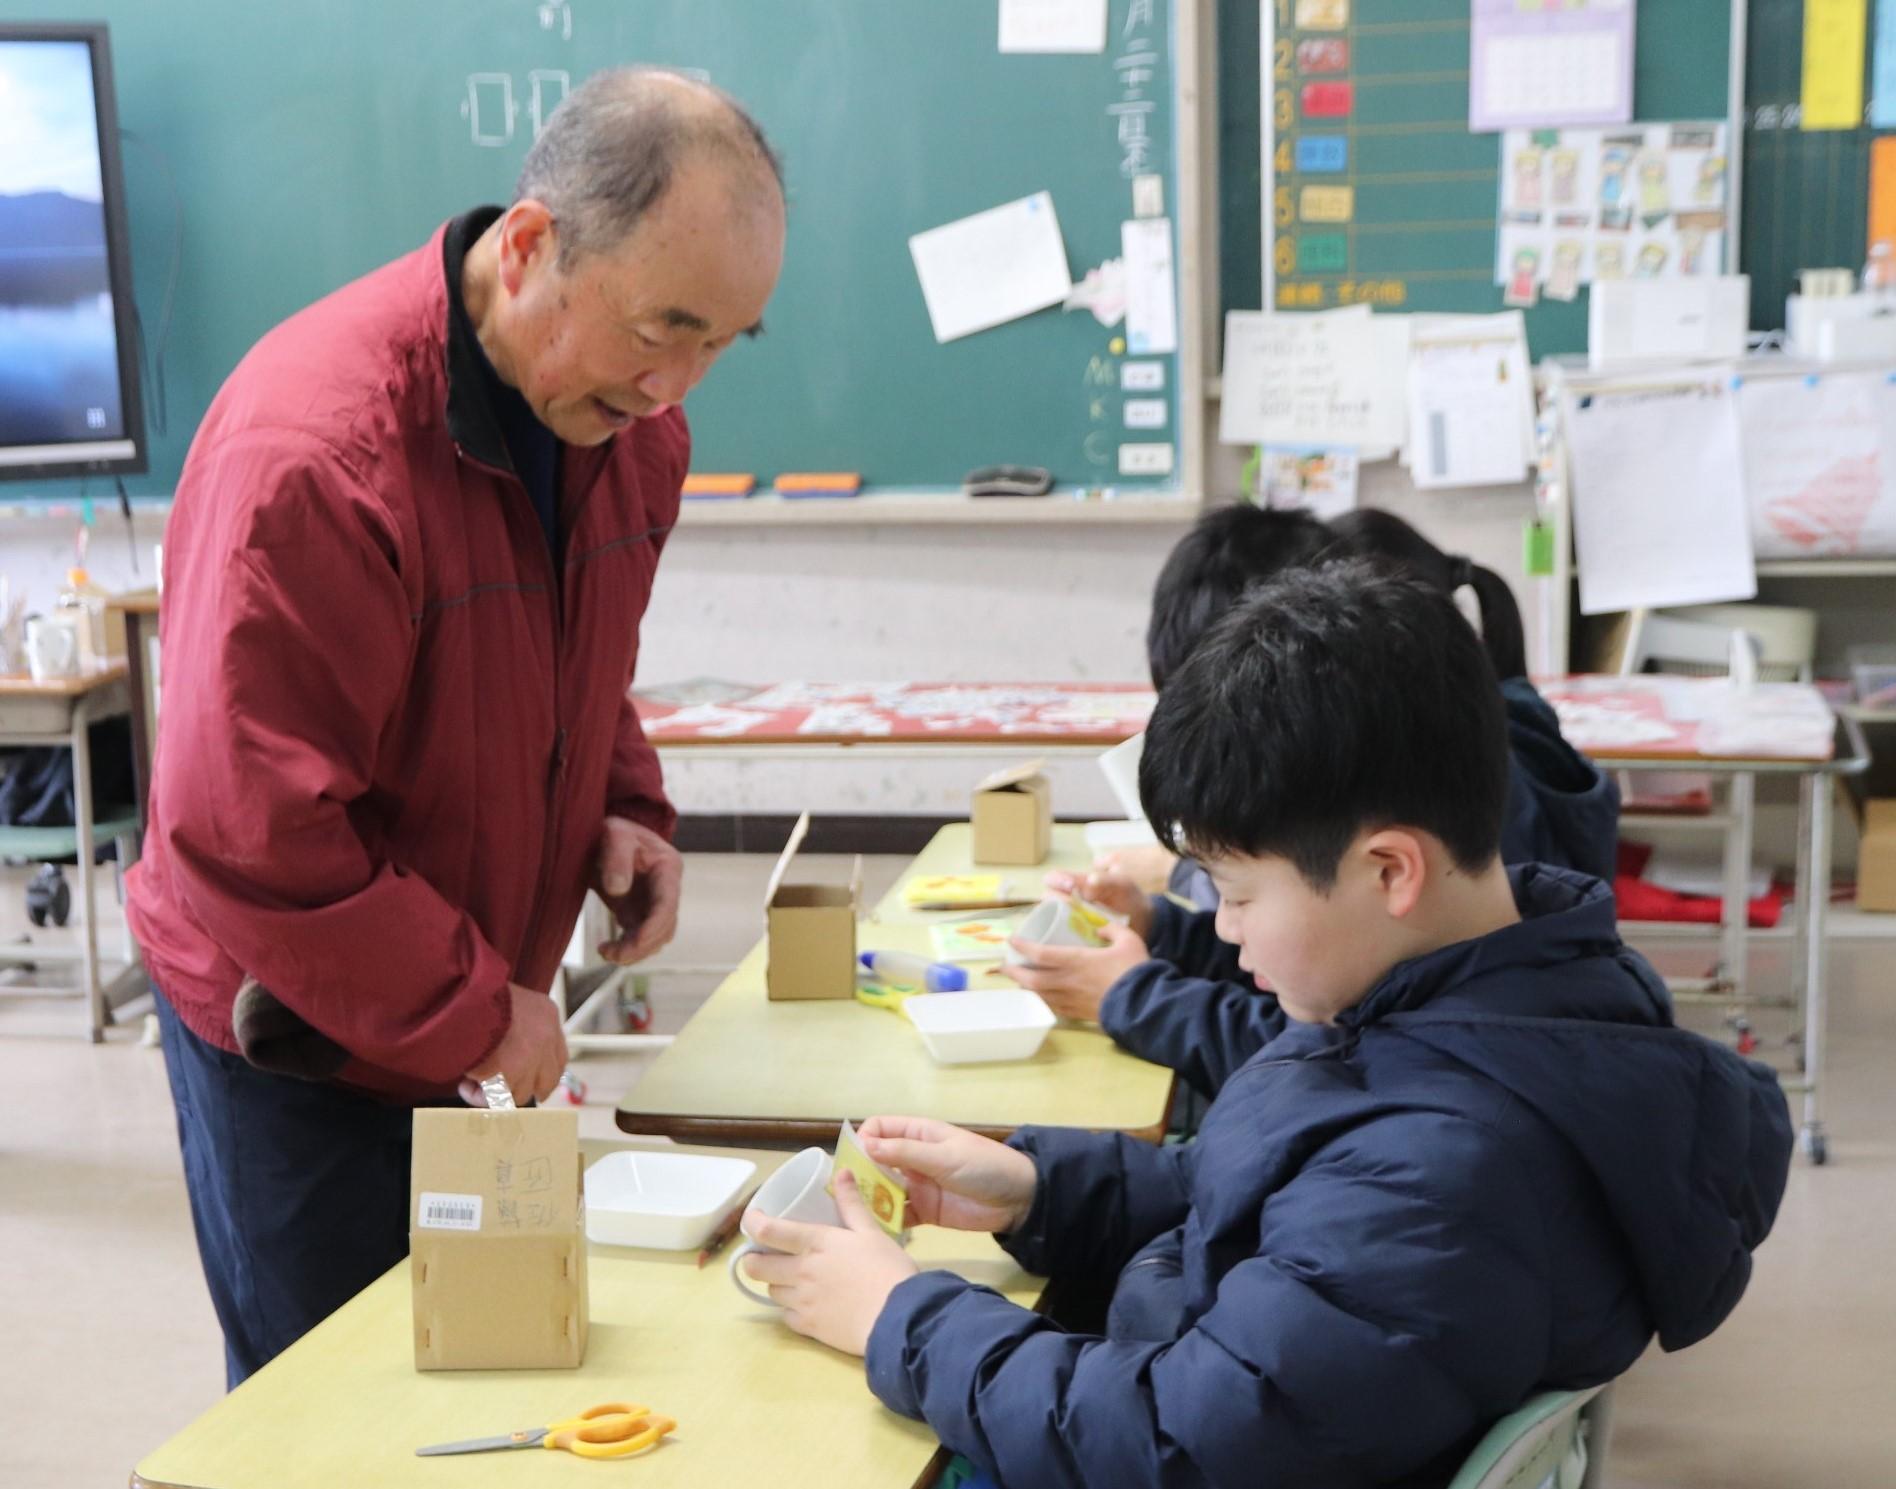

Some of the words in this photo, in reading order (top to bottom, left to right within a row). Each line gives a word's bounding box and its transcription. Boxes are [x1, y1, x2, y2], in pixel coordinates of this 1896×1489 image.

[1274, 38, 1293, 81] 2
[1274, 88, 1294, 130] 3
[1274, 139, 1292, 173] 4
[1274, 185, 1295, 228] 5
[1274, 235, 1296, 276] 6
